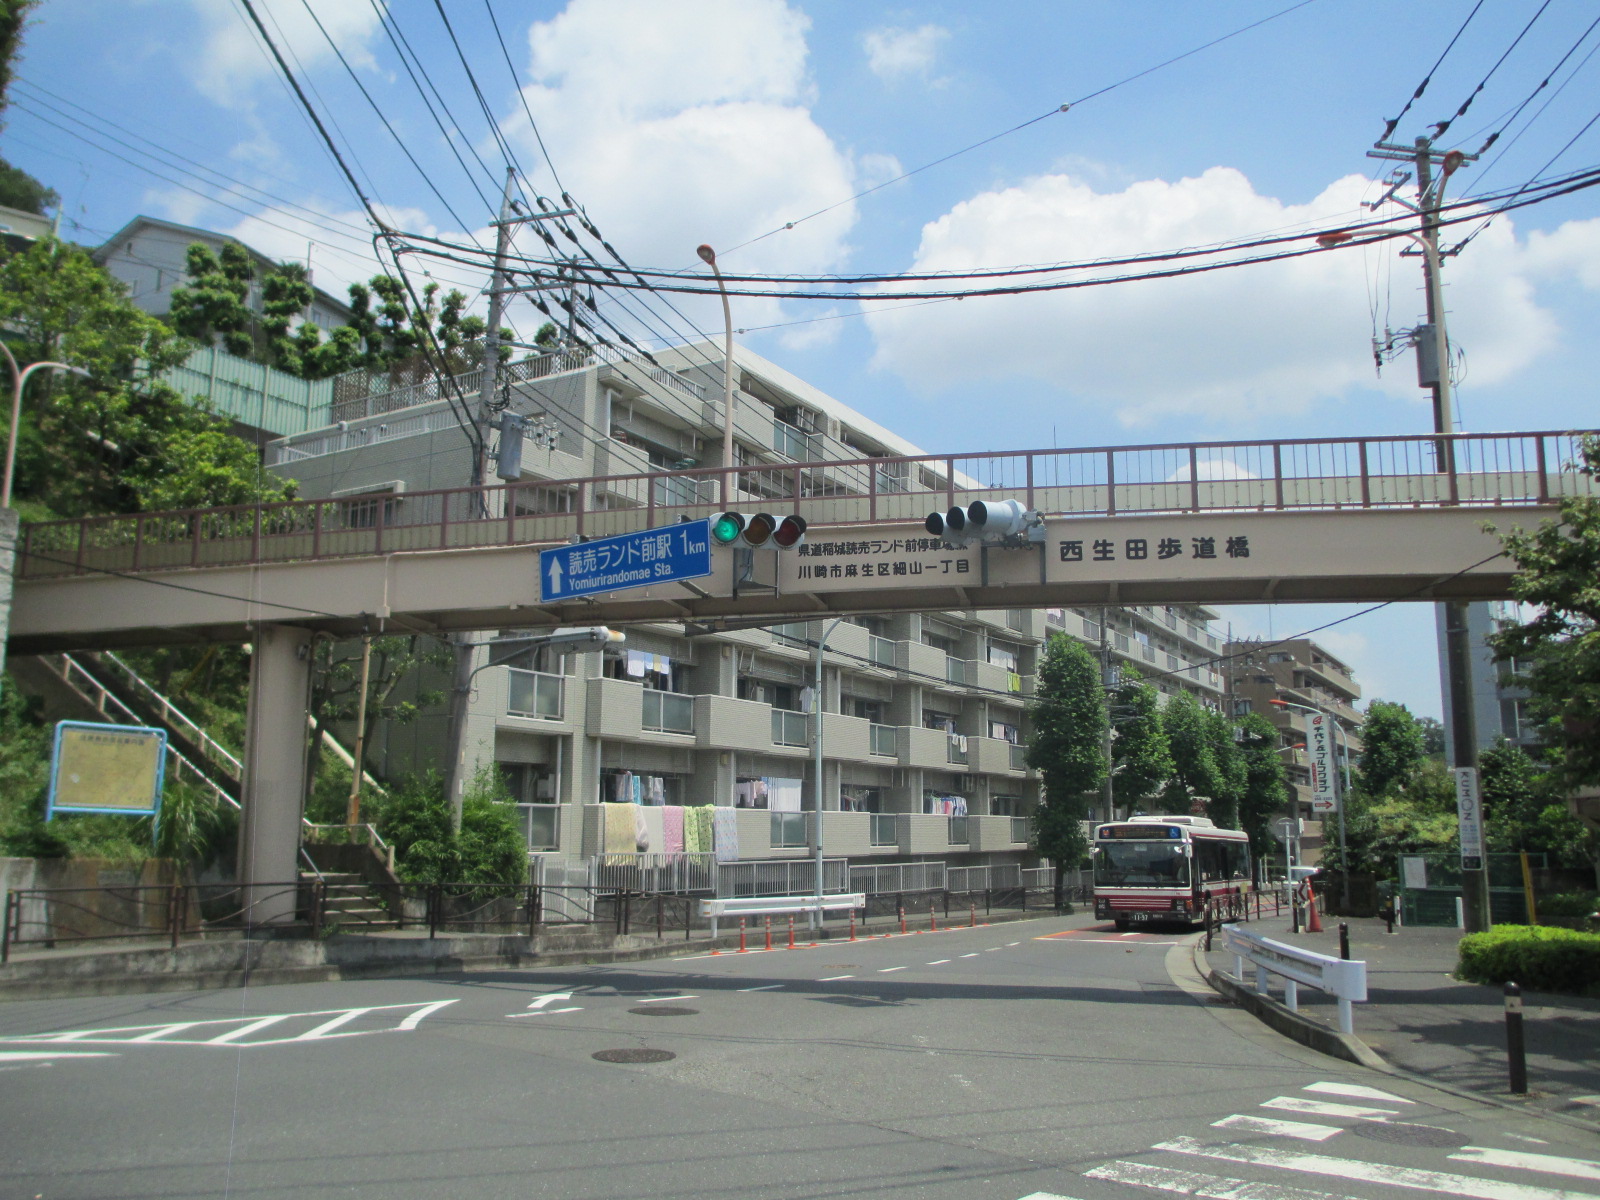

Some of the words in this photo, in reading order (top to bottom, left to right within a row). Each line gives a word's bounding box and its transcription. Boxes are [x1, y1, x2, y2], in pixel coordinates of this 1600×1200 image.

[568, 533, 672, 576] 読売ランド前駅
[1059, 536, 1250, 562] 西生田歩道橋
[569, 568, 650, 591] Yomiurirandomae
[654, 562, 674, 577] Sta.
[1460, 771, 1474, 821] KUMON
